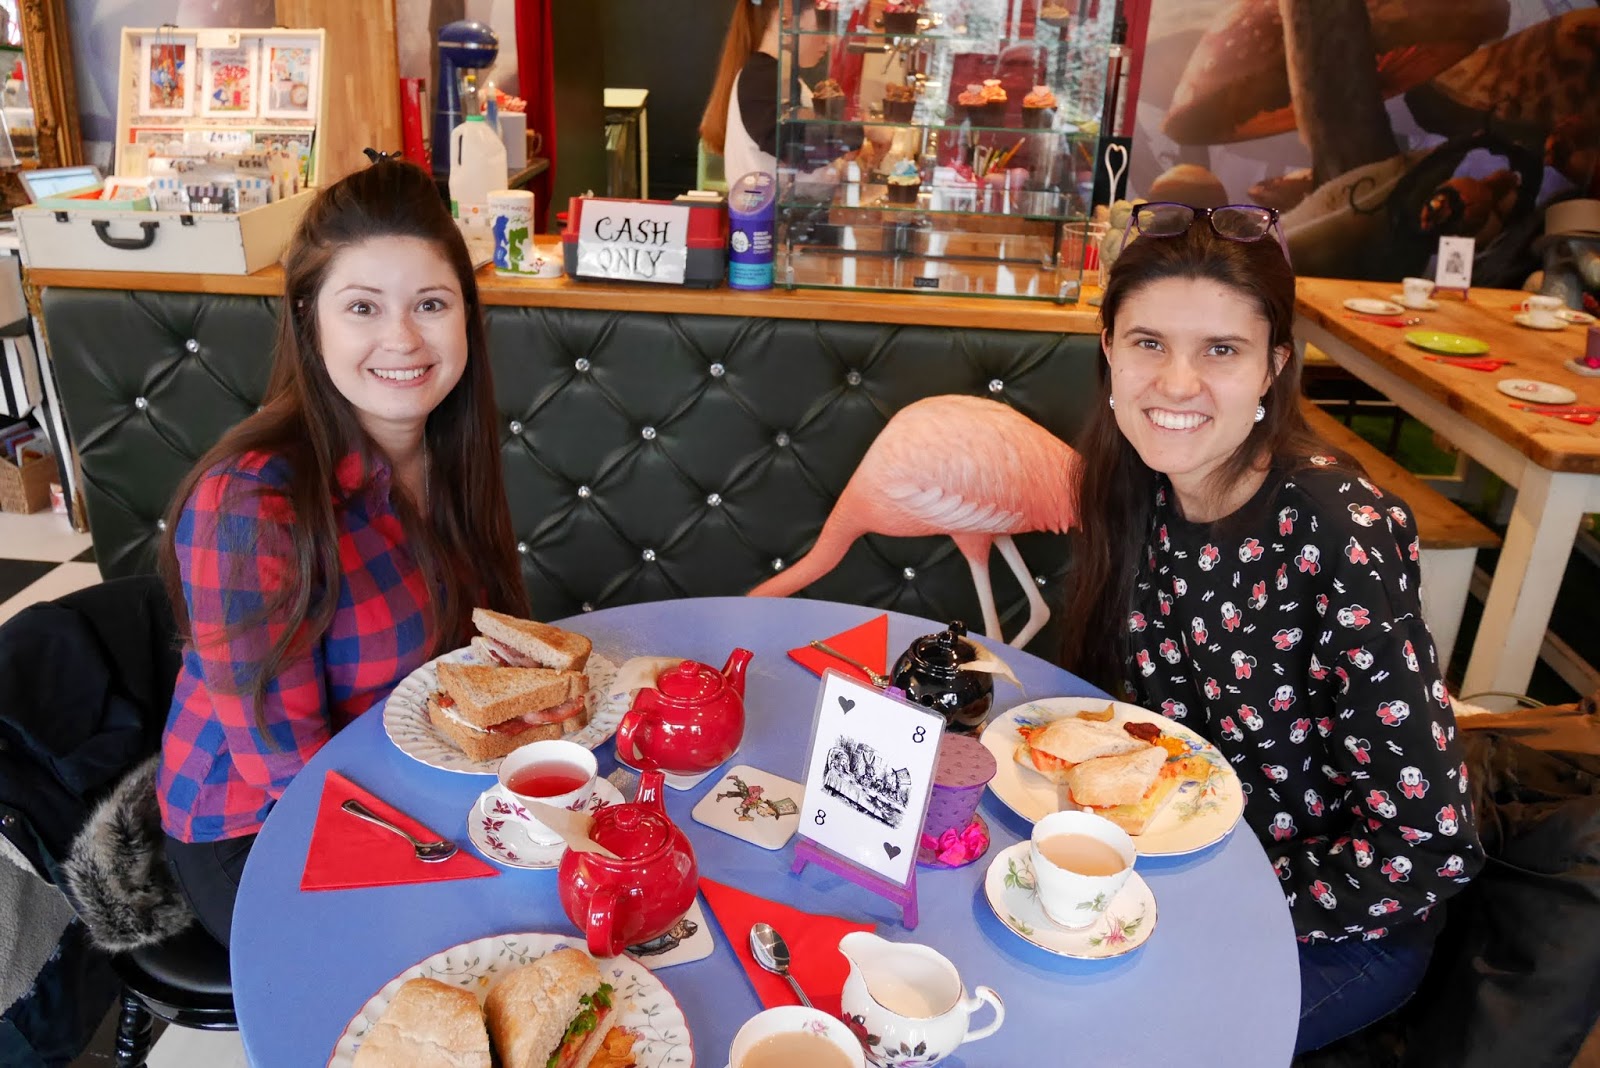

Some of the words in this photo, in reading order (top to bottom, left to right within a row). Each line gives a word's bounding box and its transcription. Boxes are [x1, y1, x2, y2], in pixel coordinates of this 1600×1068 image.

[594, 216, 672, 247] CASH
[598, 246, 666, 279] ONLY
[912, 725, 926, 744] 8
[814, 809, 827, 826] 8
